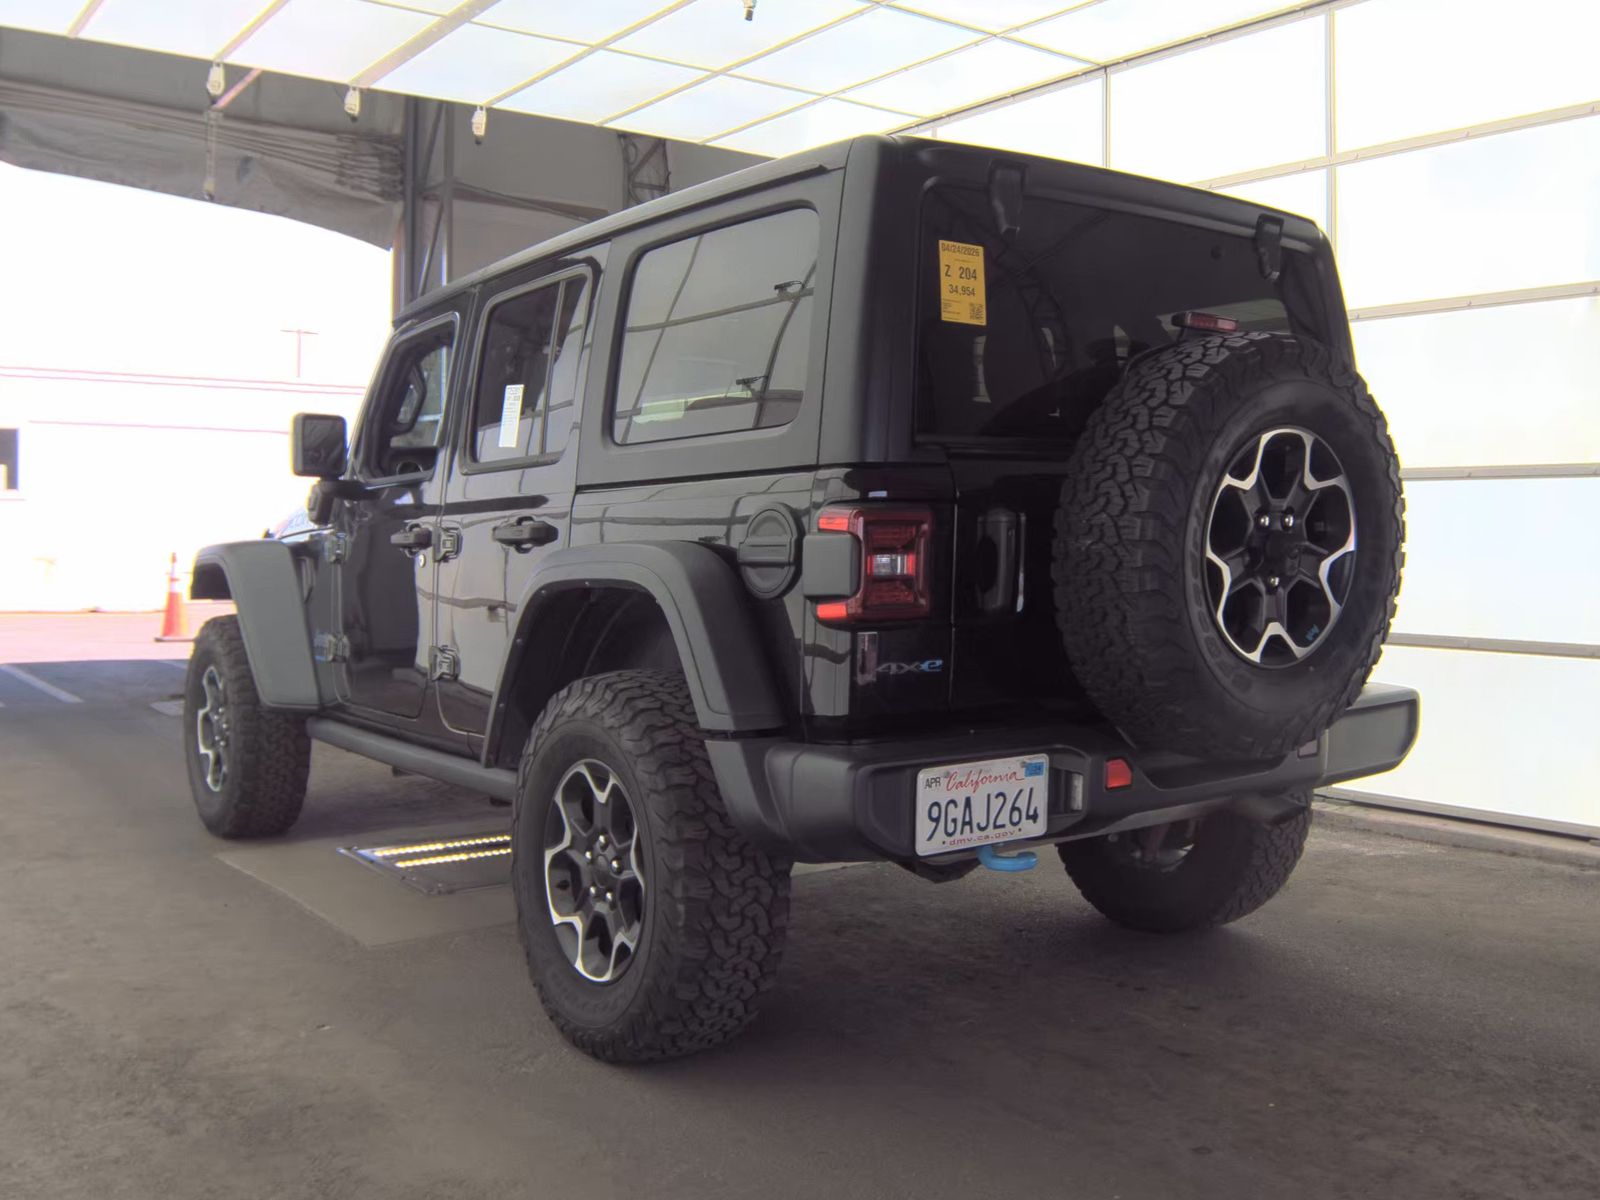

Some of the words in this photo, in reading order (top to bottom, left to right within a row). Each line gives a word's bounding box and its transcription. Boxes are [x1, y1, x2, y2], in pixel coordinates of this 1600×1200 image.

[944, 264, 952, 278] Z
[958, 266, 978, 281] 204
[948, 284, 977, 297] 34,954
[924, 776, 941, 790] APR
[945, 768, 1025, 794] California
[926, 786, 1040, 842] 9GAJ264
[949, 829, 1017, 846] dmv.ca.gov
